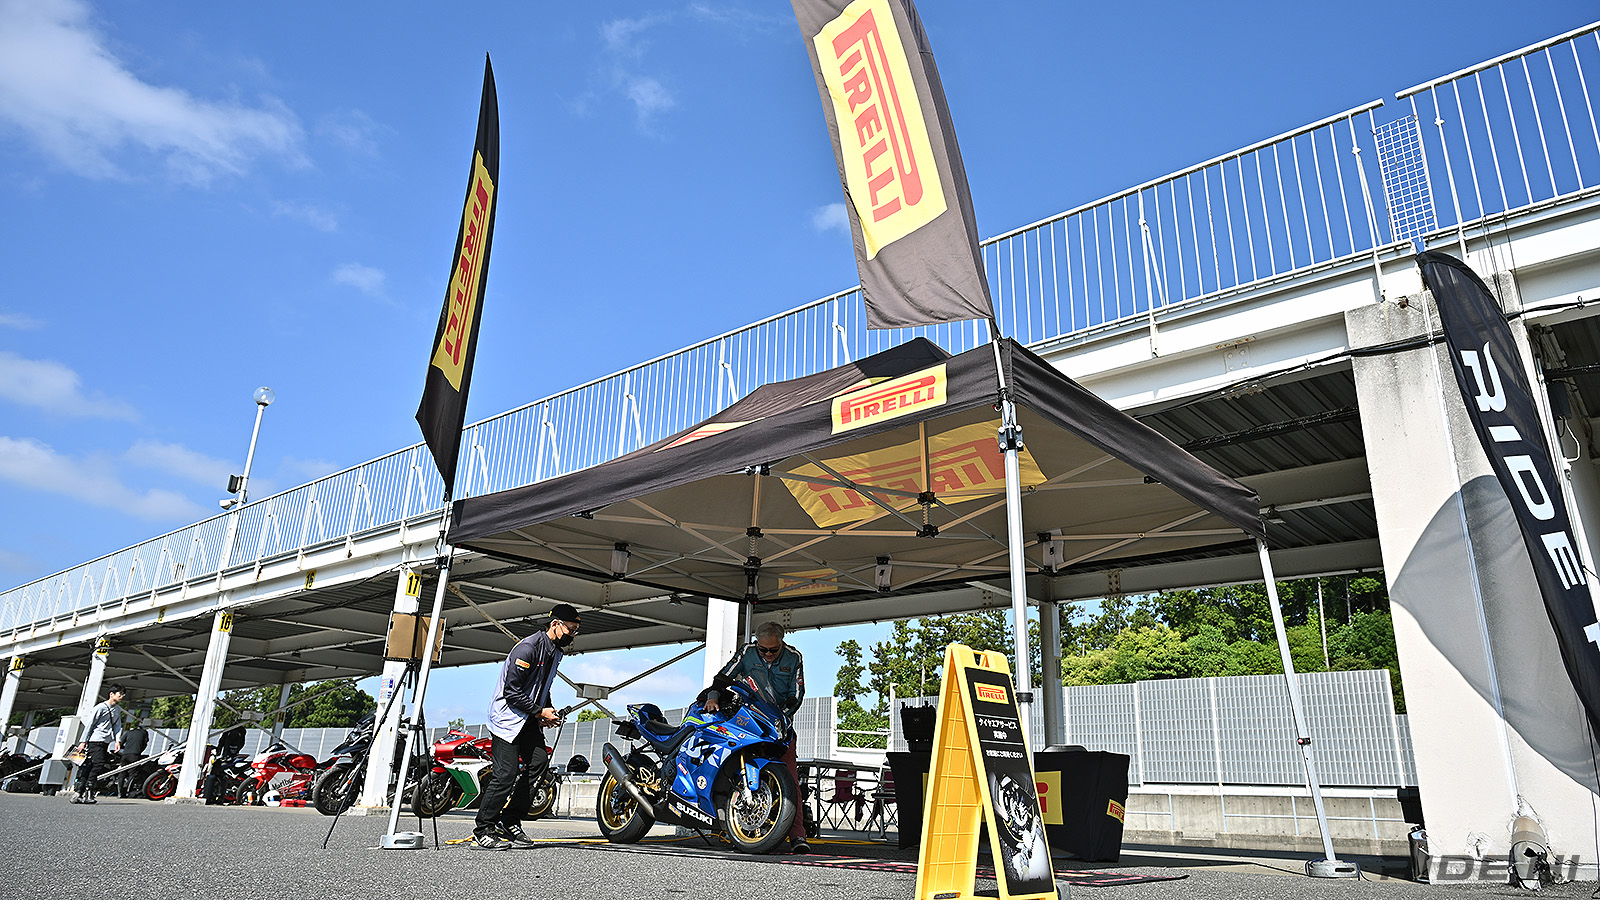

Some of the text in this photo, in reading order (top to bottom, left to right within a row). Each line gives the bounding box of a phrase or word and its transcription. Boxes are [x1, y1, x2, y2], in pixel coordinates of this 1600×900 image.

[832, 8, 924, 223] PIRELLI
[444, 176, 489, 366] PIRELLI
[840, 375, 936, 425] PIRELLI
[1460, 340, 1586, 591] RIDE
[408, 574, 420, 594] 17
[220, 614, 232, 631] 16
[977, 686, 1006, 700] PIRELLI
[676, 801, 713, 826] SUZUKI
